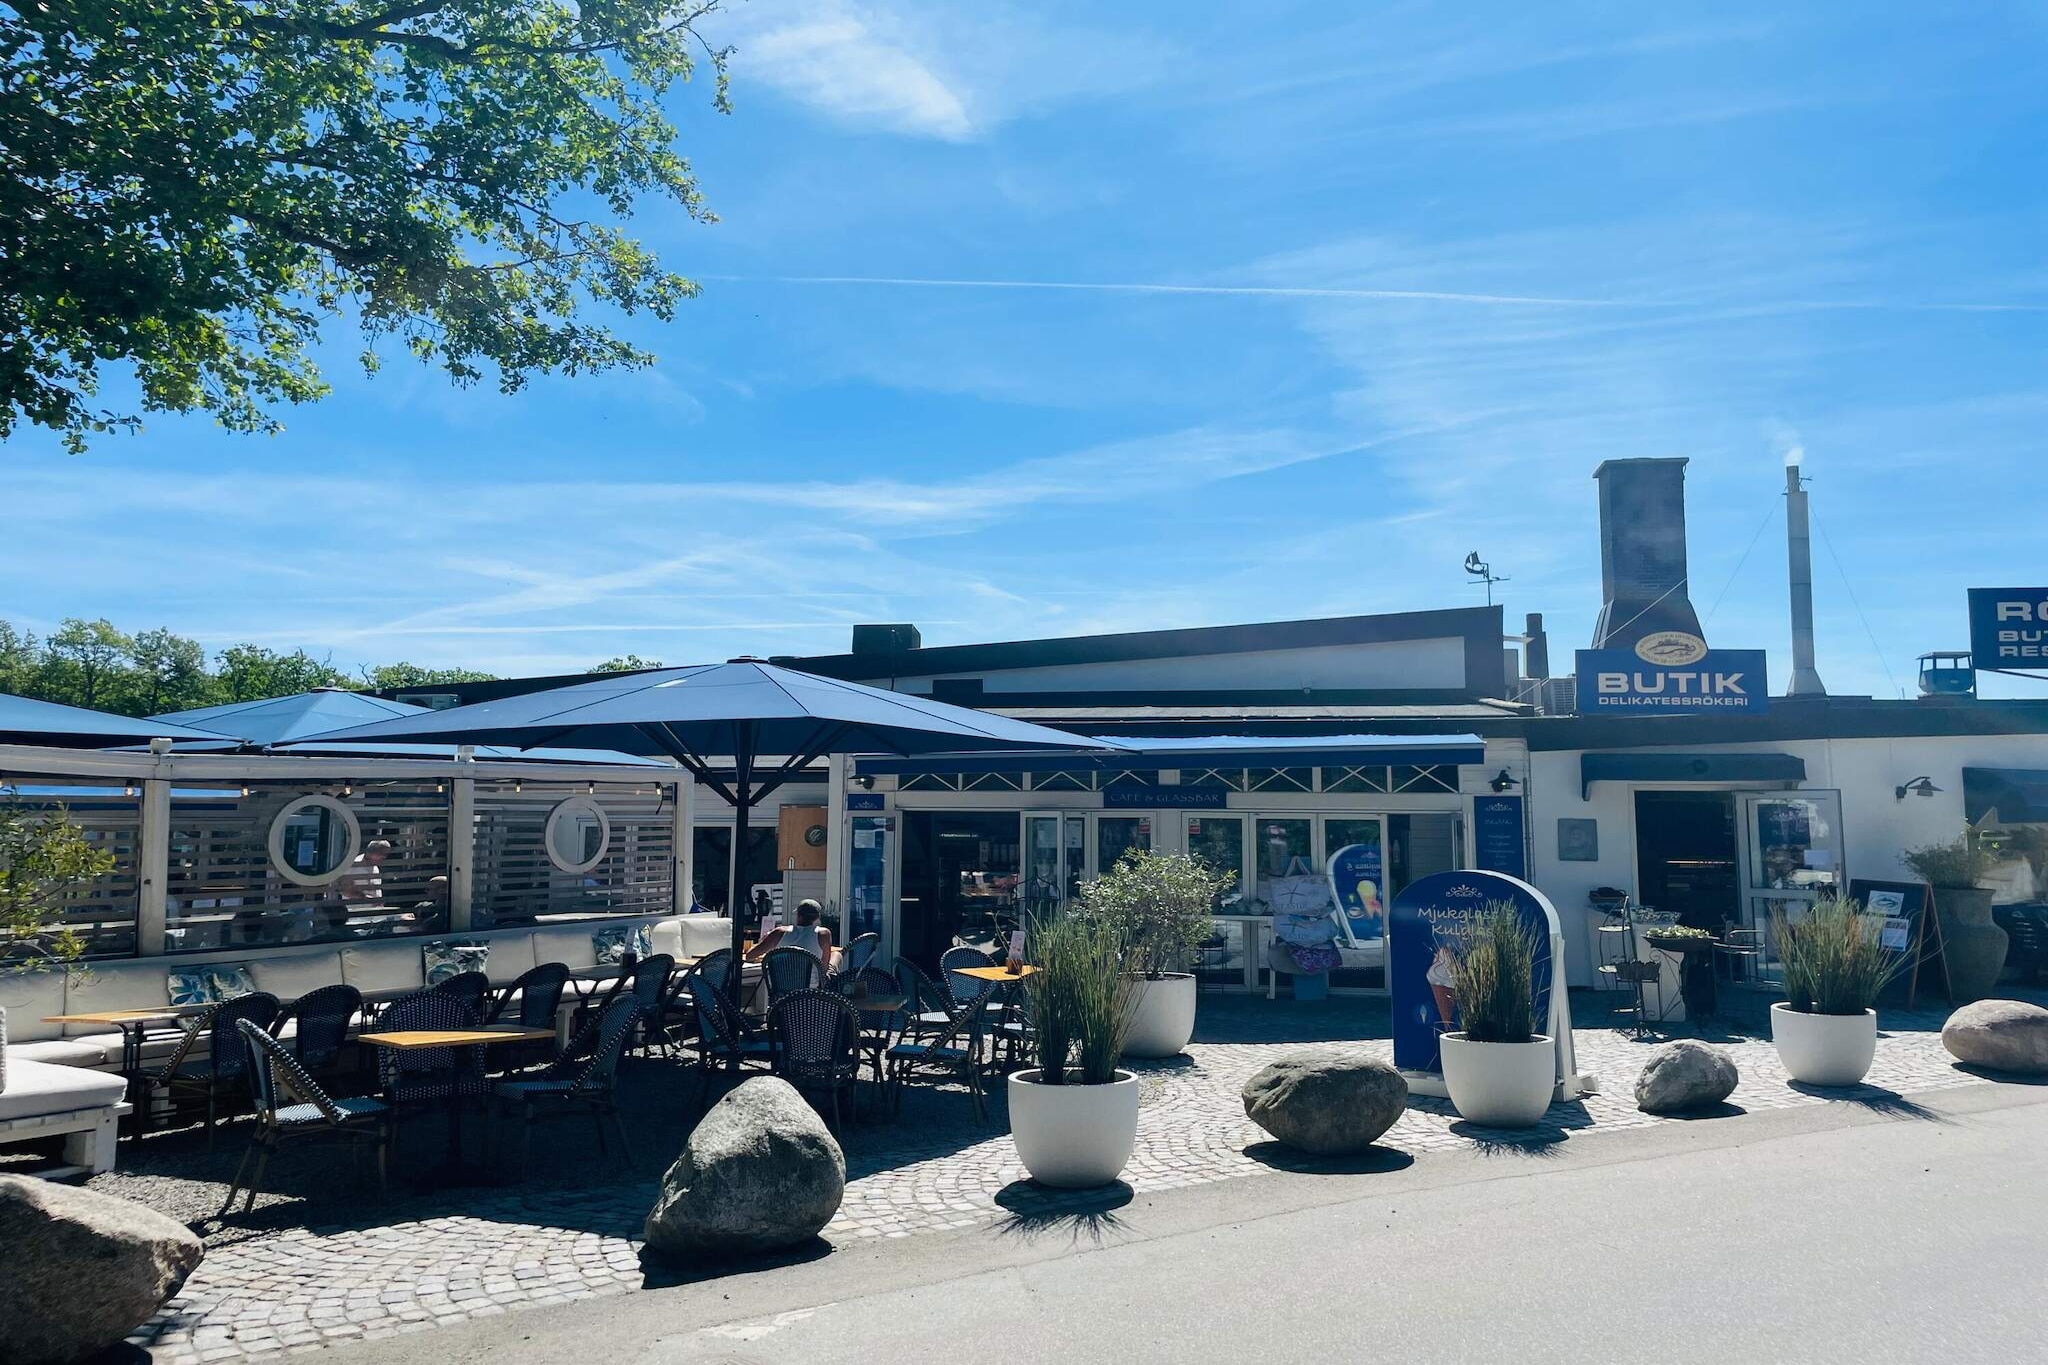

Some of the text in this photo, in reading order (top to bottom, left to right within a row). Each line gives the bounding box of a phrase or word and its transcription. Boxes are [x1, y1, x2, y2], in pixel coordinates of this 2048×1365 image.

[1998, 630, 2048, 641] BU
[1598, 672, 1746, 694] BUTIK
[1599, 694, 1748, 706] DELIKATESSRÖKERI
